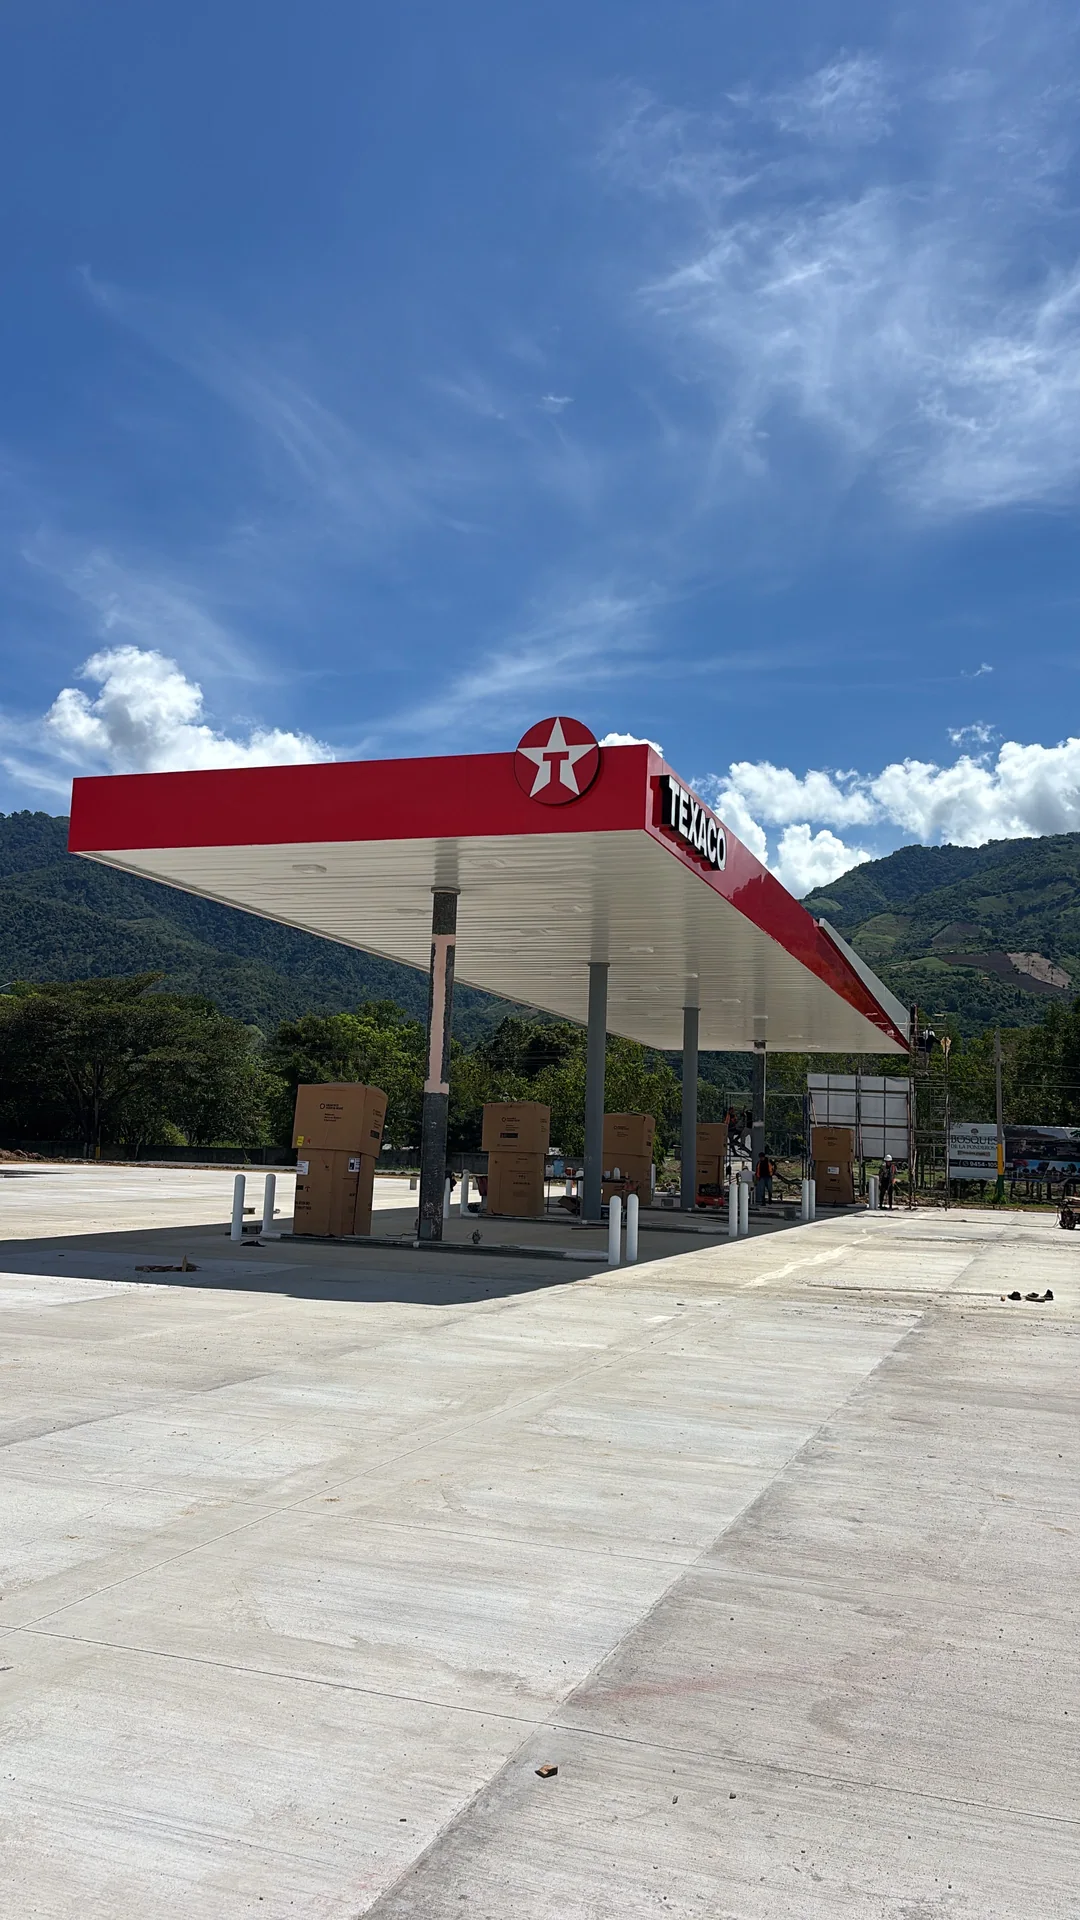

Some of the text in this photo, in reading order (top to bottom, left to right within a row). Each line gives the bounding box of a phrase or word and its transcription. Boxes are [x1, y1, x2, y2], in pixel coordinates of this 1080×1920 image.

[543, 751, 569, 784] T
[668, 775, 727, 871] TEXACO
[950, 1135, 998, 1145] BOSQUES
